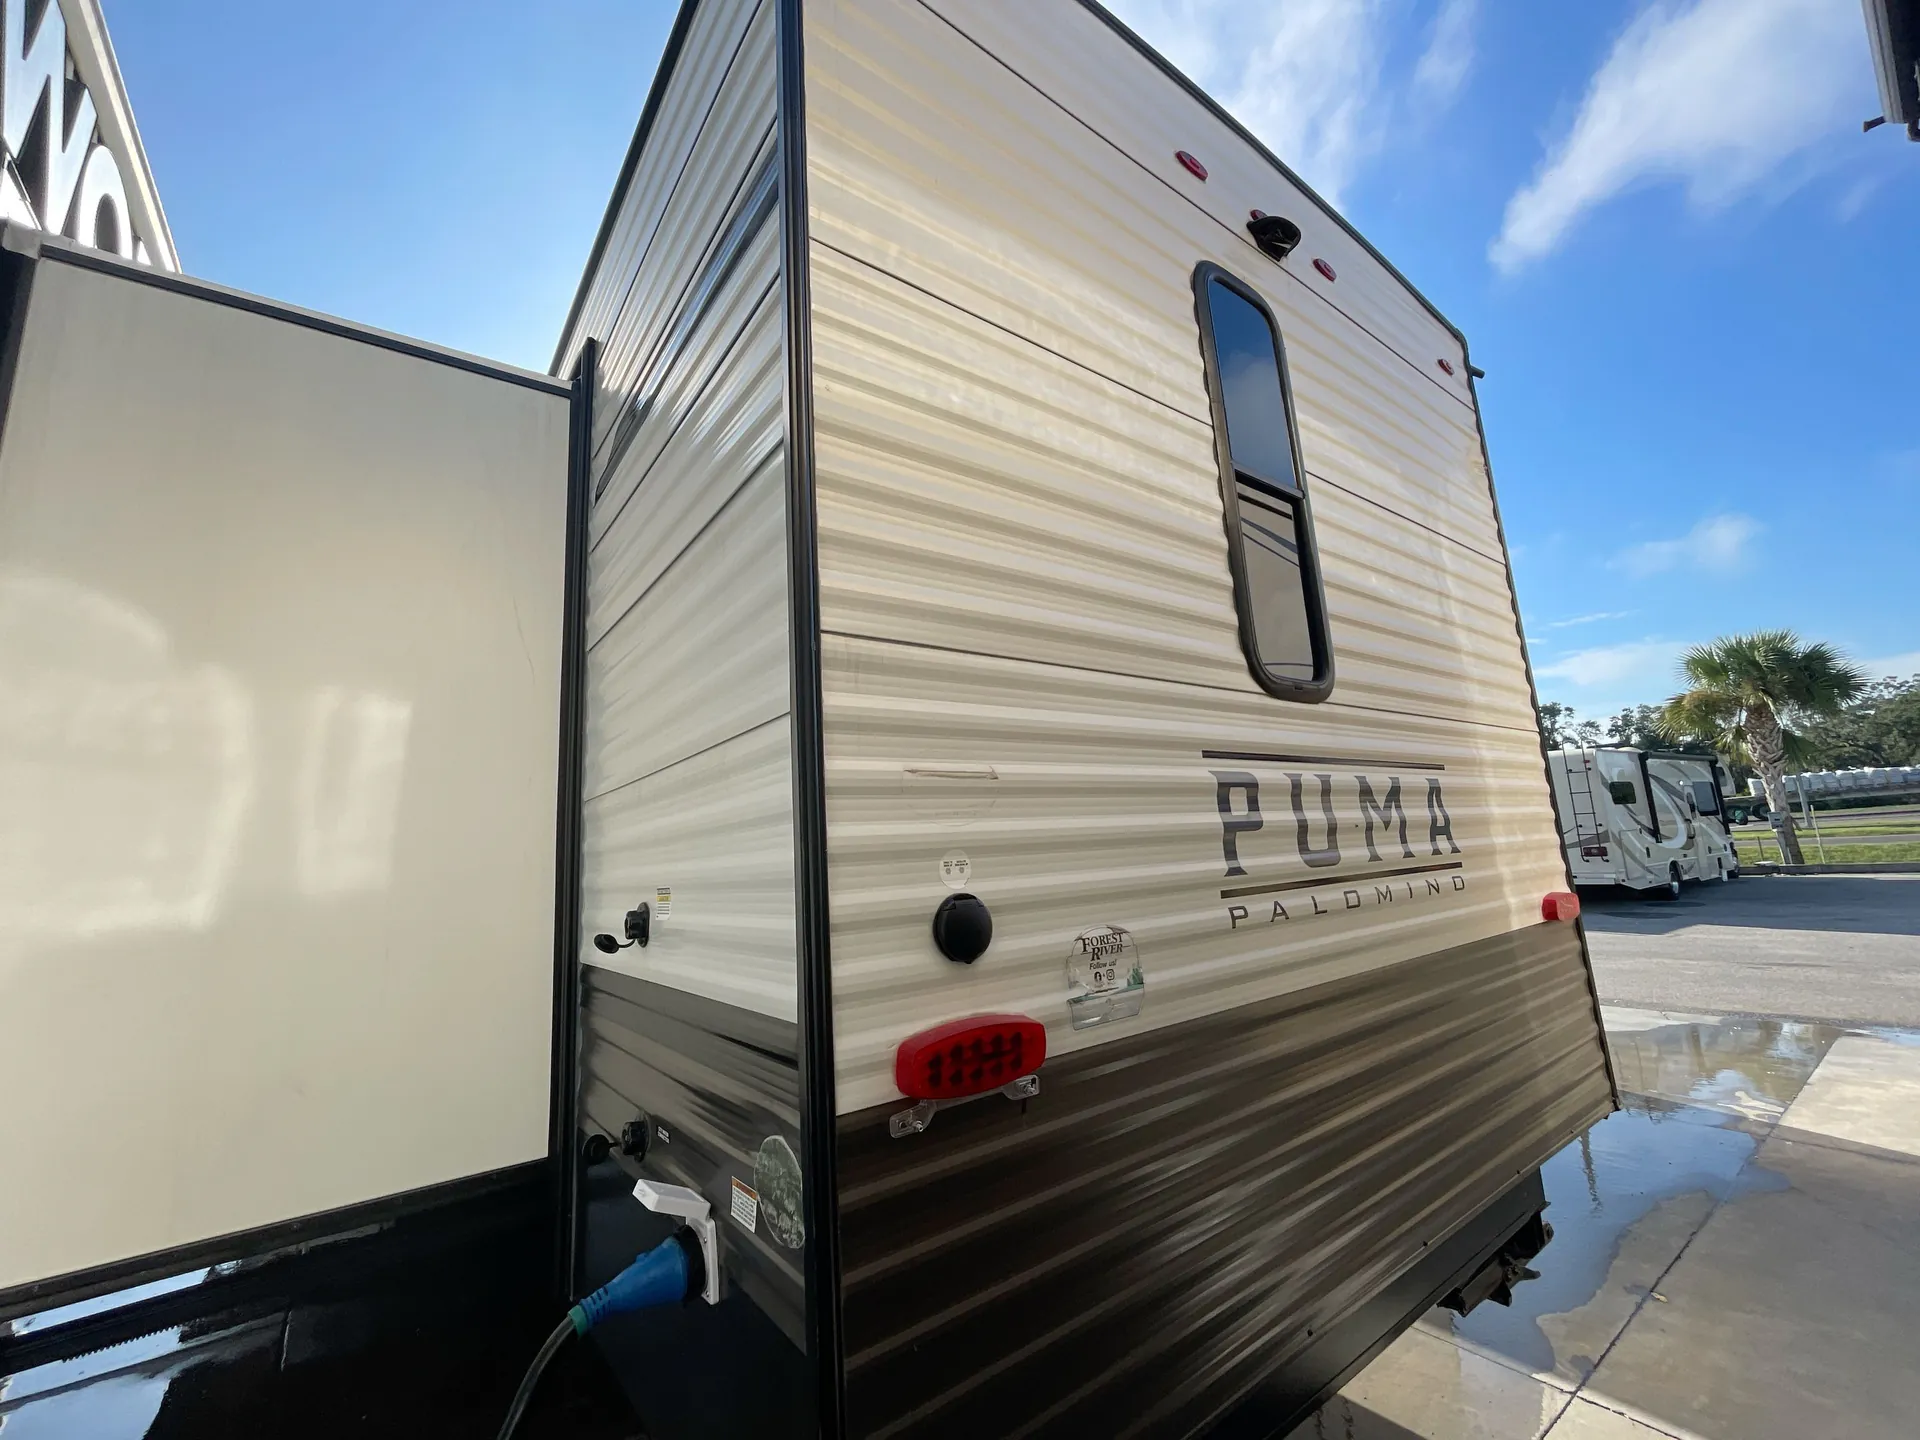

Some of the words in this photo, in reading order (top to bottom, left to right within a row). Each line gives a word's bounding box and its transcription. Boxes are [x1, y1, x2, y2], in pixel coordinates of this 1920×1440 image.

[1208, 770, 1462, 877] PUMA
[1228, 875, 1465, 929] PALOMINO
[1081, 933, 1123, 952] FOREST
[1090, 943, 1123, 962] RIVER
[1089, 962, 1107, 970] Follow
